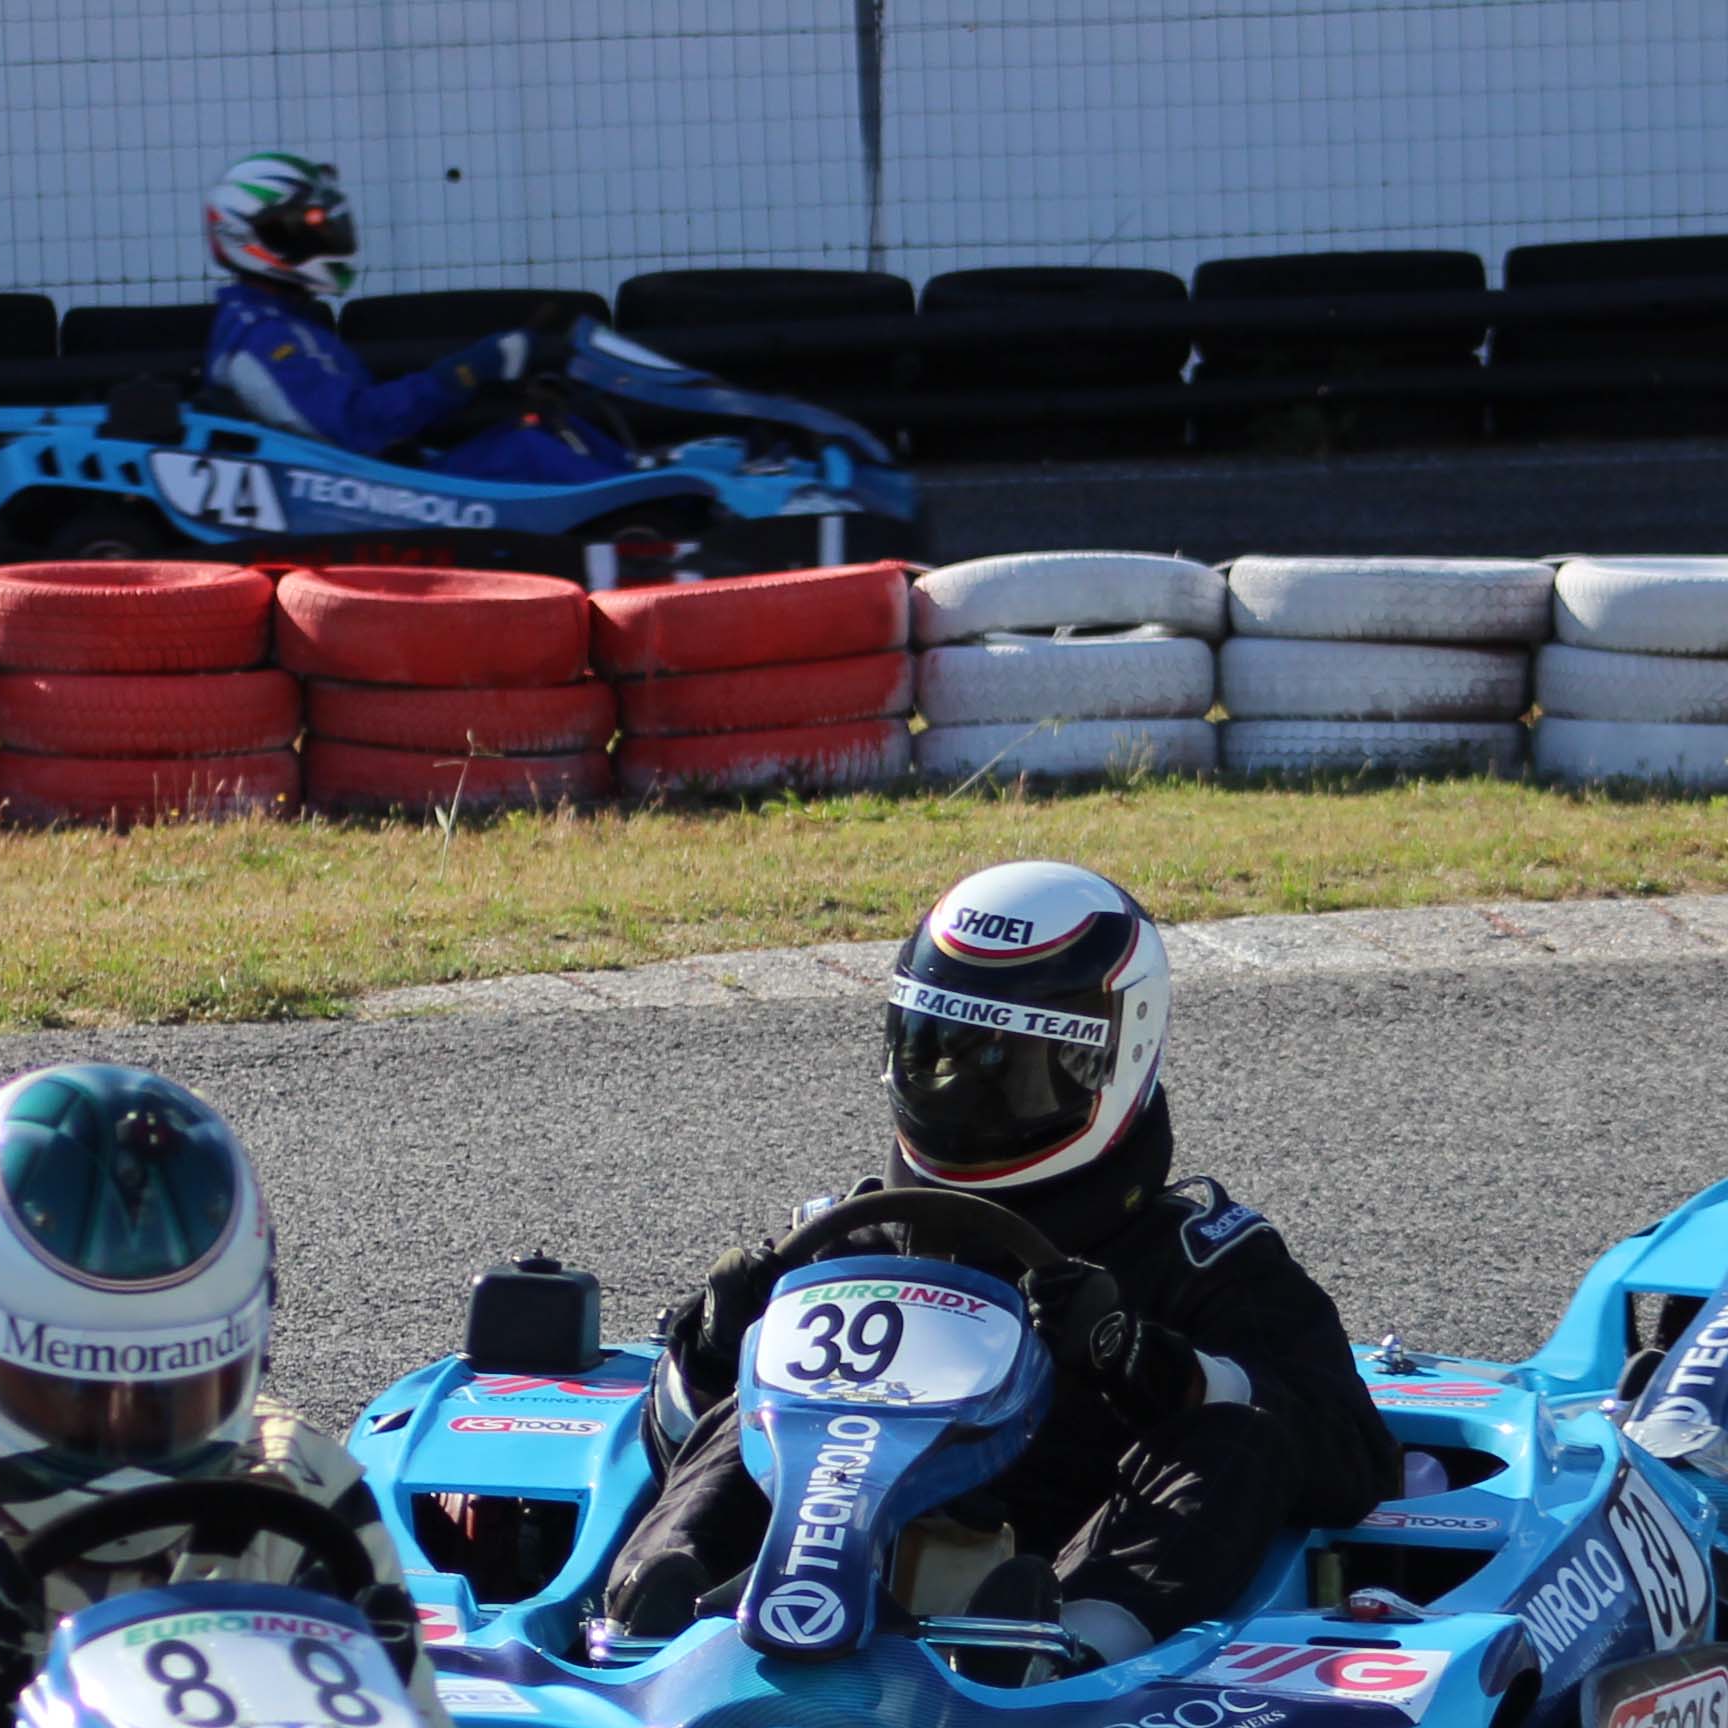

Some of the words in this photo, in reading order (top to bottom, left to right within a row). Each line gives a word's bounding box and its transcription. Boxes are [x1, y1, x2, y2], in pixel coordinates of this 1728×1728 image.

[283, 469, 497, 528] TECNIROLO
[948, 907, 1034, 946] SHOEI
[914, 988, 1013, 1026] RACING
[1023, 1012, 1106, 1042] TEAM
[799, 1284, 992, 1314] EUROINDY
[785, 1300, 905, 1383] 39
[785, 1414, 882, 1577] TECNIROLO
[1614, 1490, 1693, 1638] 39
[123, 1615, 359, 1647] EUROINDY
[1518, 1538, 1625, 1673] NIROLO
